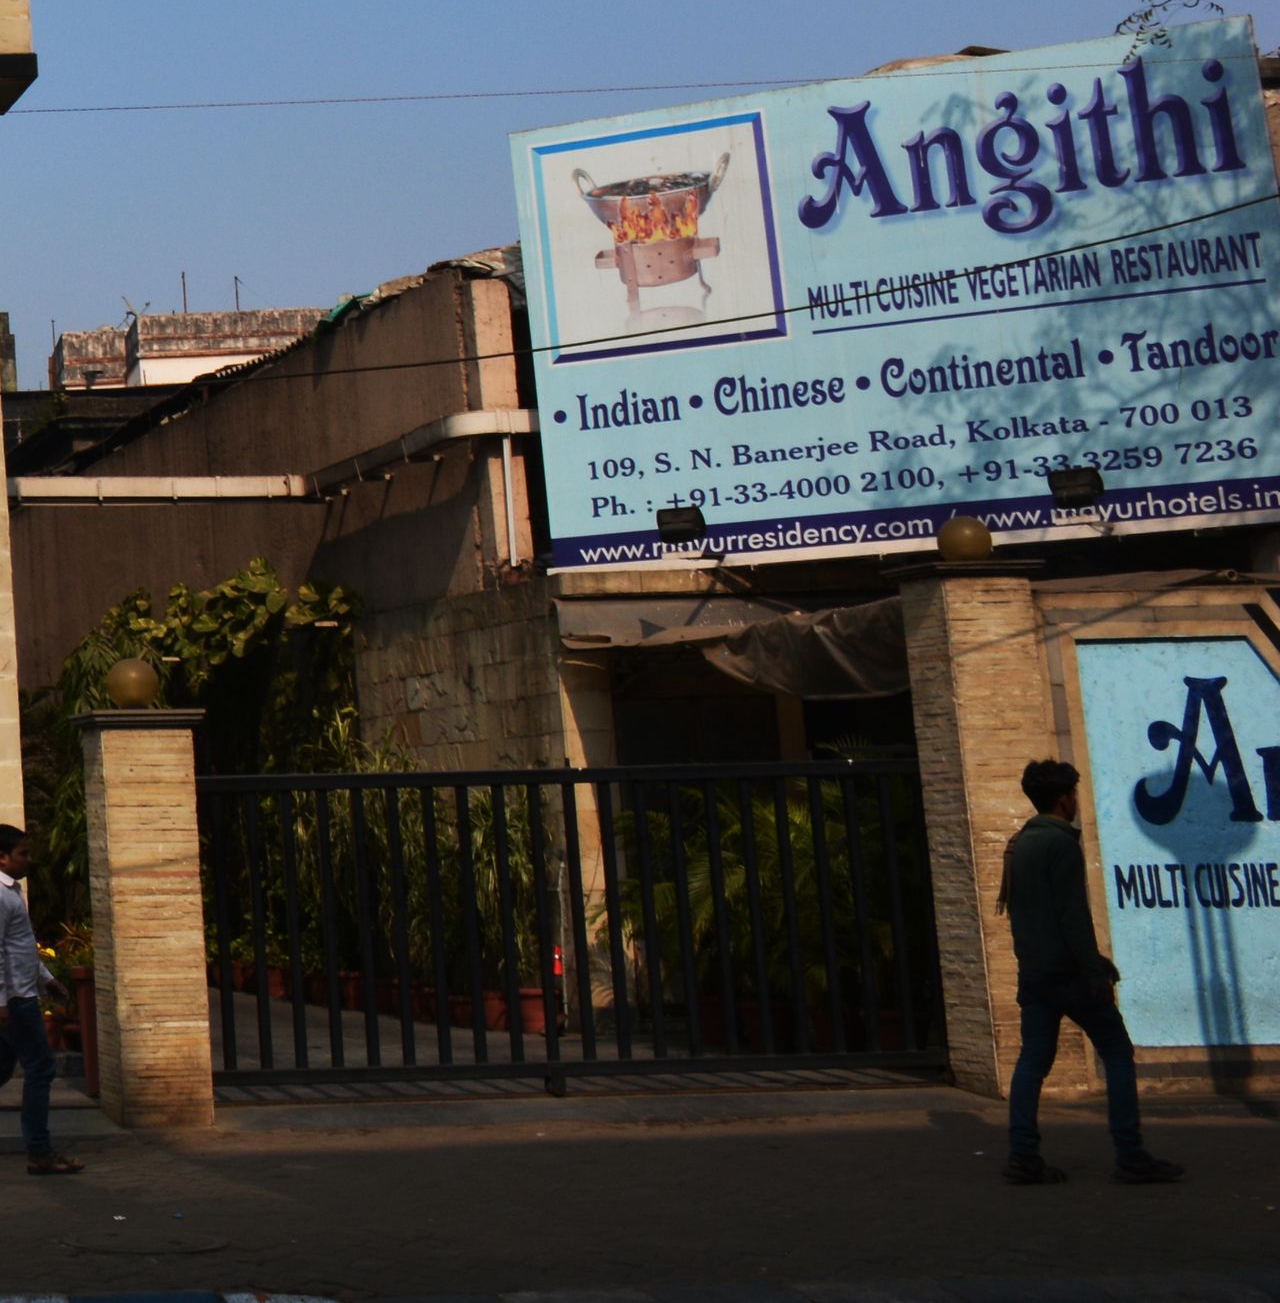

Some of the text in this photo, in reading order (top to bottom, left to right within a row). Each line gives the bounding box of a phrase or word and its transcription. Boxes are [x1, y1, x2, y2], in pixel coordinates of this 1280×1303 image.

[798, 55, 1247, 234] Angithi
[806, 231, 1262, 320] MULTI CUISINE VEGETARIAN RESTAURANT
[576, 323, 1280, 431] Indian Chinese Continental Tandoor
[587, 457, 645, 481] 109,
[654, 452, 681, 474] S.
[690, 447, 722, 470] N.
[732, 436, 859, 467] Banerjee
[869, 424, 956, 452] Road,
[966, 415, 1090, 445] Kolkata
[1119, 402, 1180, 429] 700
[1191, 395, 1253, 421] 013
[591, 494, 636, 518] Ph.
[666, 473, 851, 512] +91-33-4000
[861, 465, 945, 493] 2100,
[1174, 437, 1258, 467] 7236
[1133, 675, 1280, 825] A
[1114, 862, 1280, 909] MULTI CUISINE
